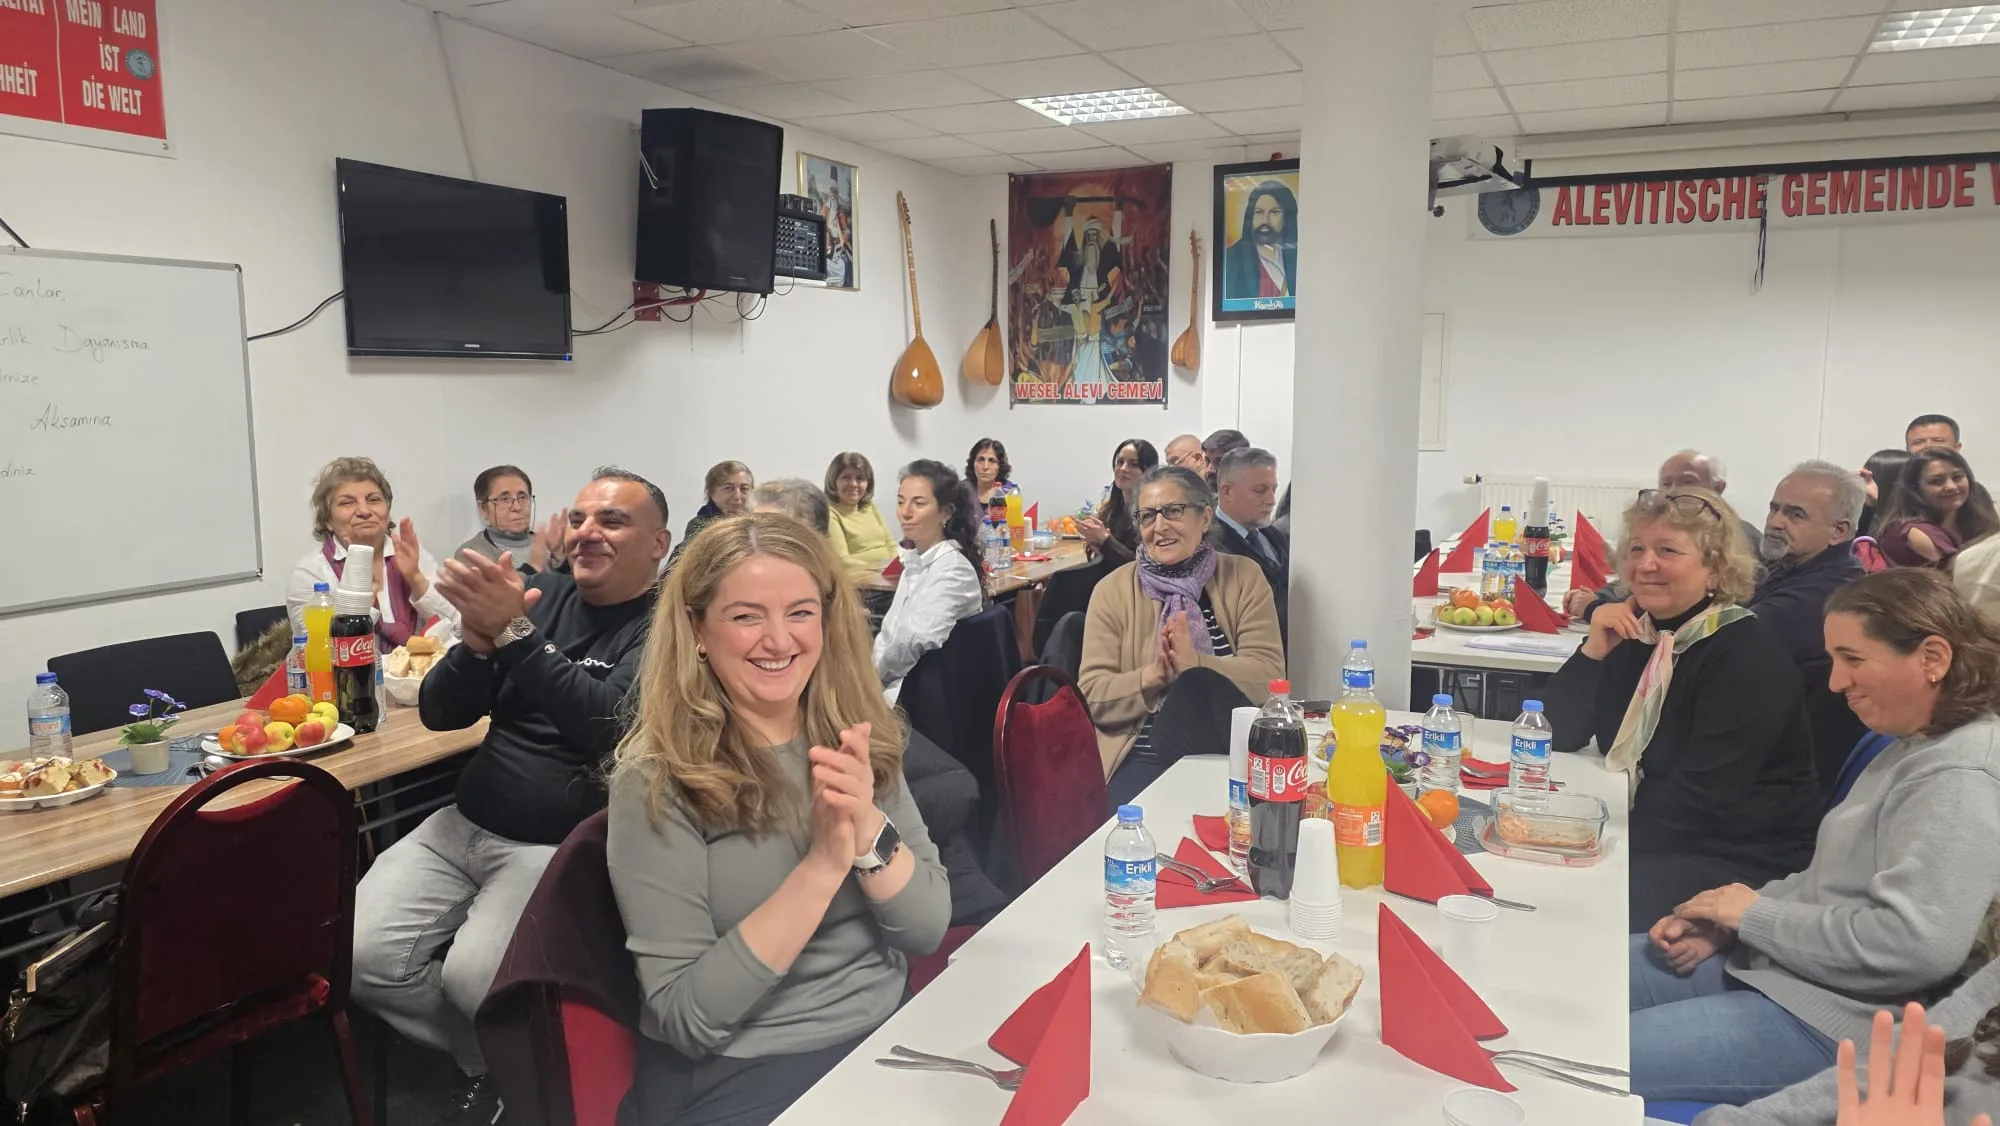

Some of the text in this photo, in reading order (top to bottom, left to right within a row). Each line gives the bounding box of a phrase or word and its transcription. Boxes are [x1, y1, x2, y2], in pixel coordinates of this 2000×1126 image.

[66, 0, 102, 28] MEIN
[113, 6, 146, 38] LAND
[108, 84, 142, 116] WELT
[1552, 175, 1769, 226] ALEVITISCHE
[1781, 163, 1975, 217] GEMEINDE
[1016, 382, 1061, 400] WESEL
[1424, 731, 1445, 742] Erikli
[1515, 738, 1537, 750] Erikli
[1125, 862, 1152, 875] Erikli
